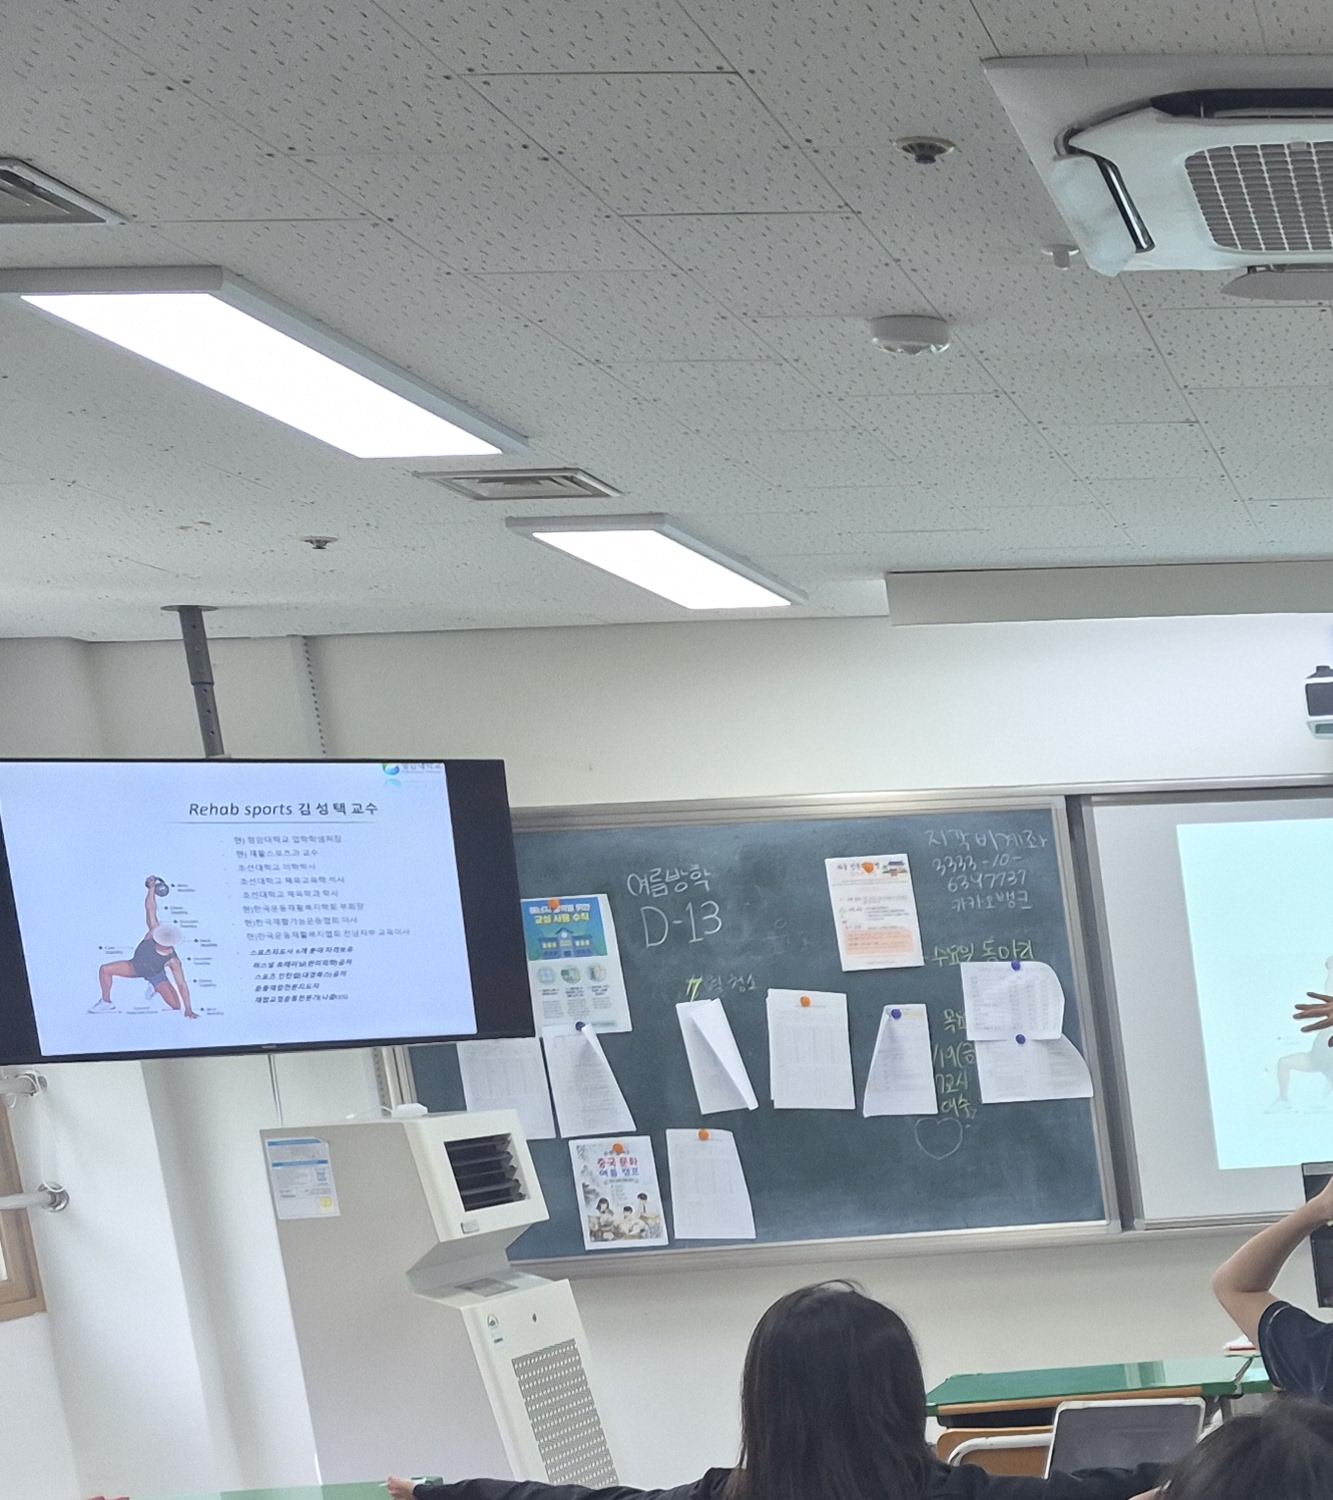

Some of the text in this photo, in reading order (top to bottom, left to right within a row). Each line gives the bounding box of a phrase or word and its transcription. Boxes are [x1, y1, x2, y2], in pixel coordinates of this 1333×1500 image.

[189, 803, 239, 816] Rehab
[244, 803, 293, 818] sports
[627, 864, 712, 898] 여름방학
[951, 890, 1033, 912] 카카오뱅크
[640, 900, 722, 948] D-13
